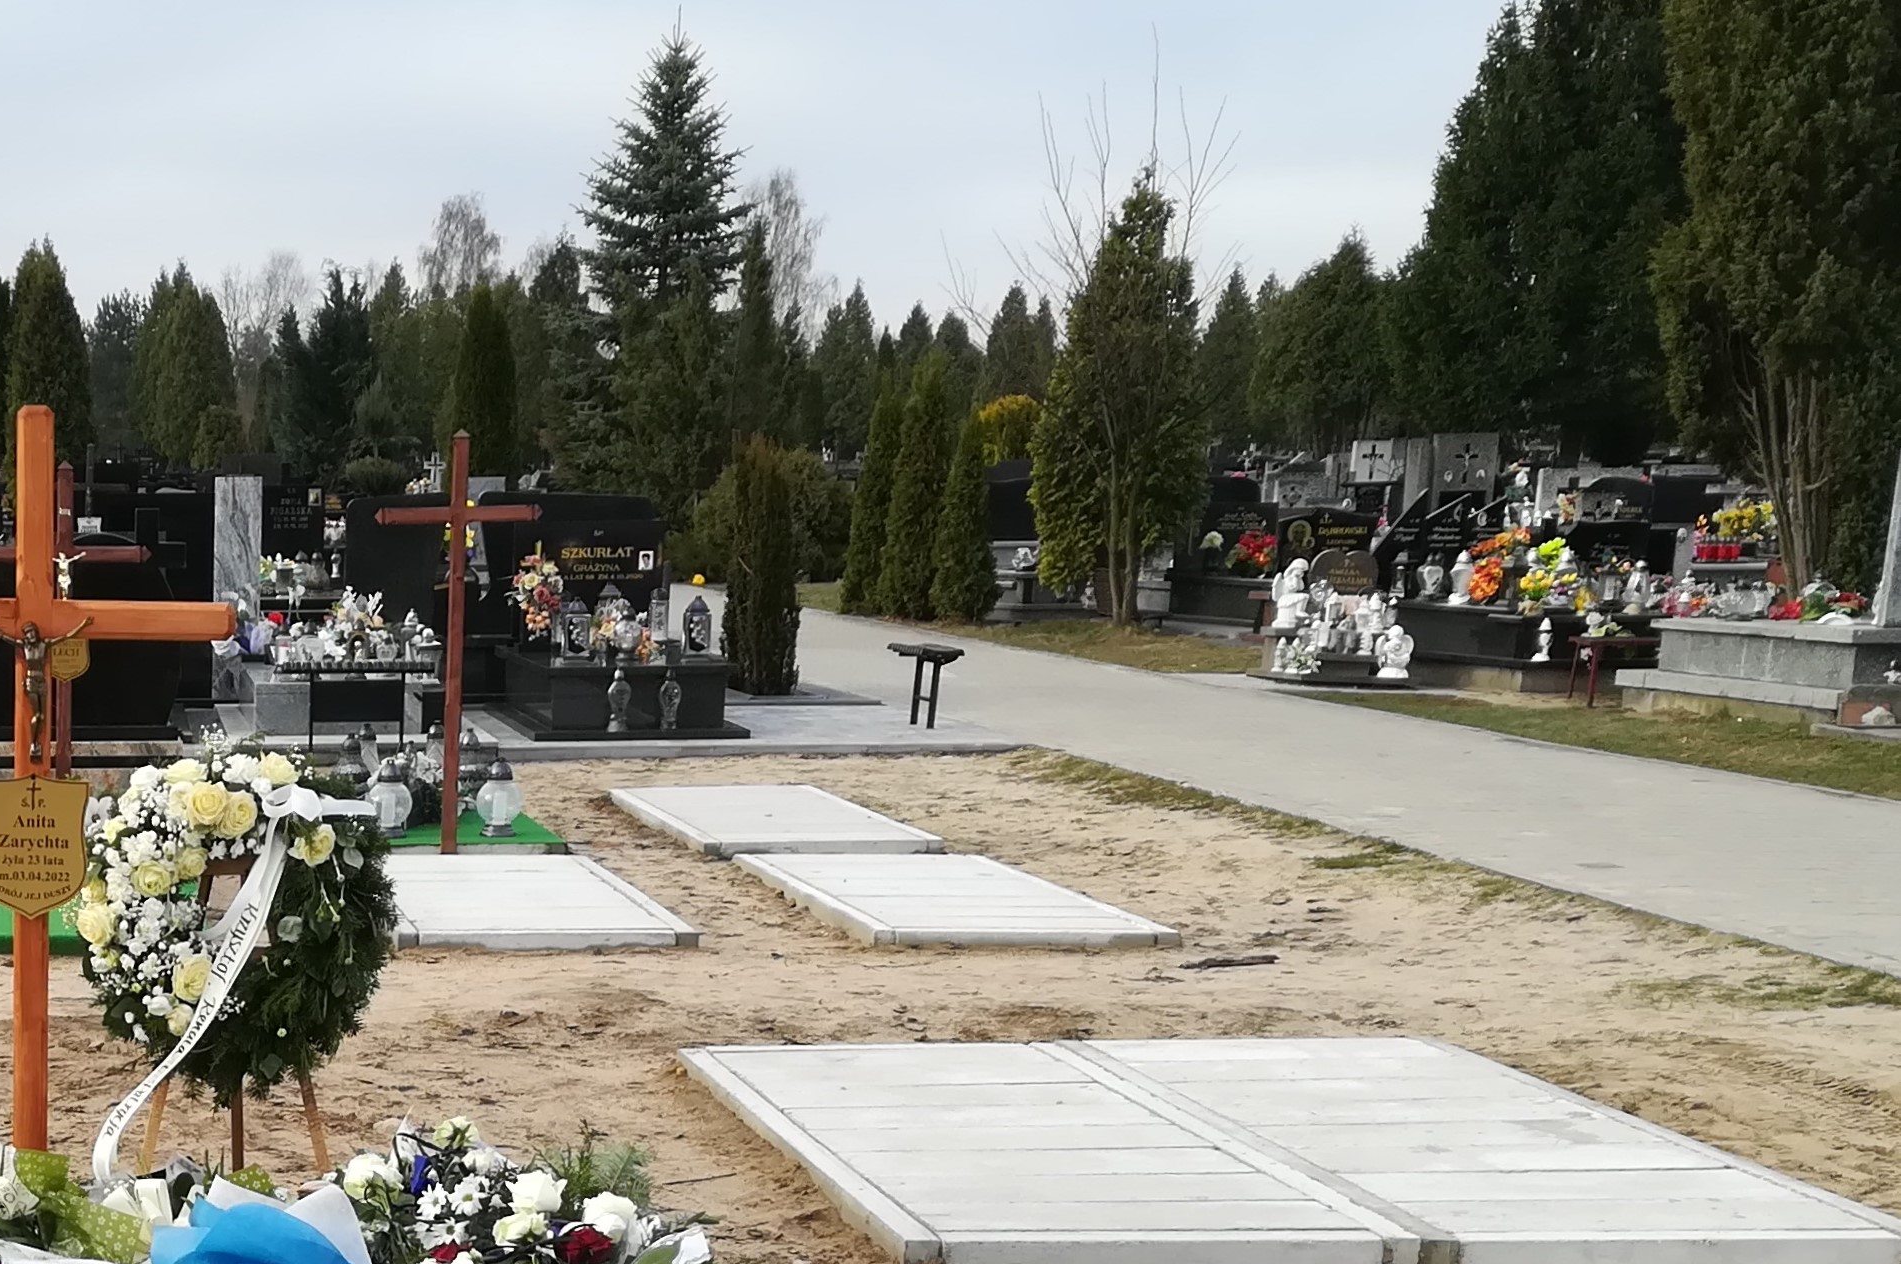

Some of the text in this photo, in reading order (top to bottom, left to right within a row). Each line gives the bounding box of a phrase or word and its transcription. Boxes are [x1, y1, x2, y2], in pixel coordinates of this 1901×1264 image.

[561, 546, 634, 559] SZKURŁAT
[573, 563, 620, 572] GRAŻYNA
[13, 815, 56, 828] Anita
[0, 834, 69, 851] Zarychta
[2, 854, 64, 867] żyła 23 lata
[44, 884, 72, 900] DUSZY
[211, 903, 259, 984] Krzysztof
[176, 997, 216, 1054] Renata
